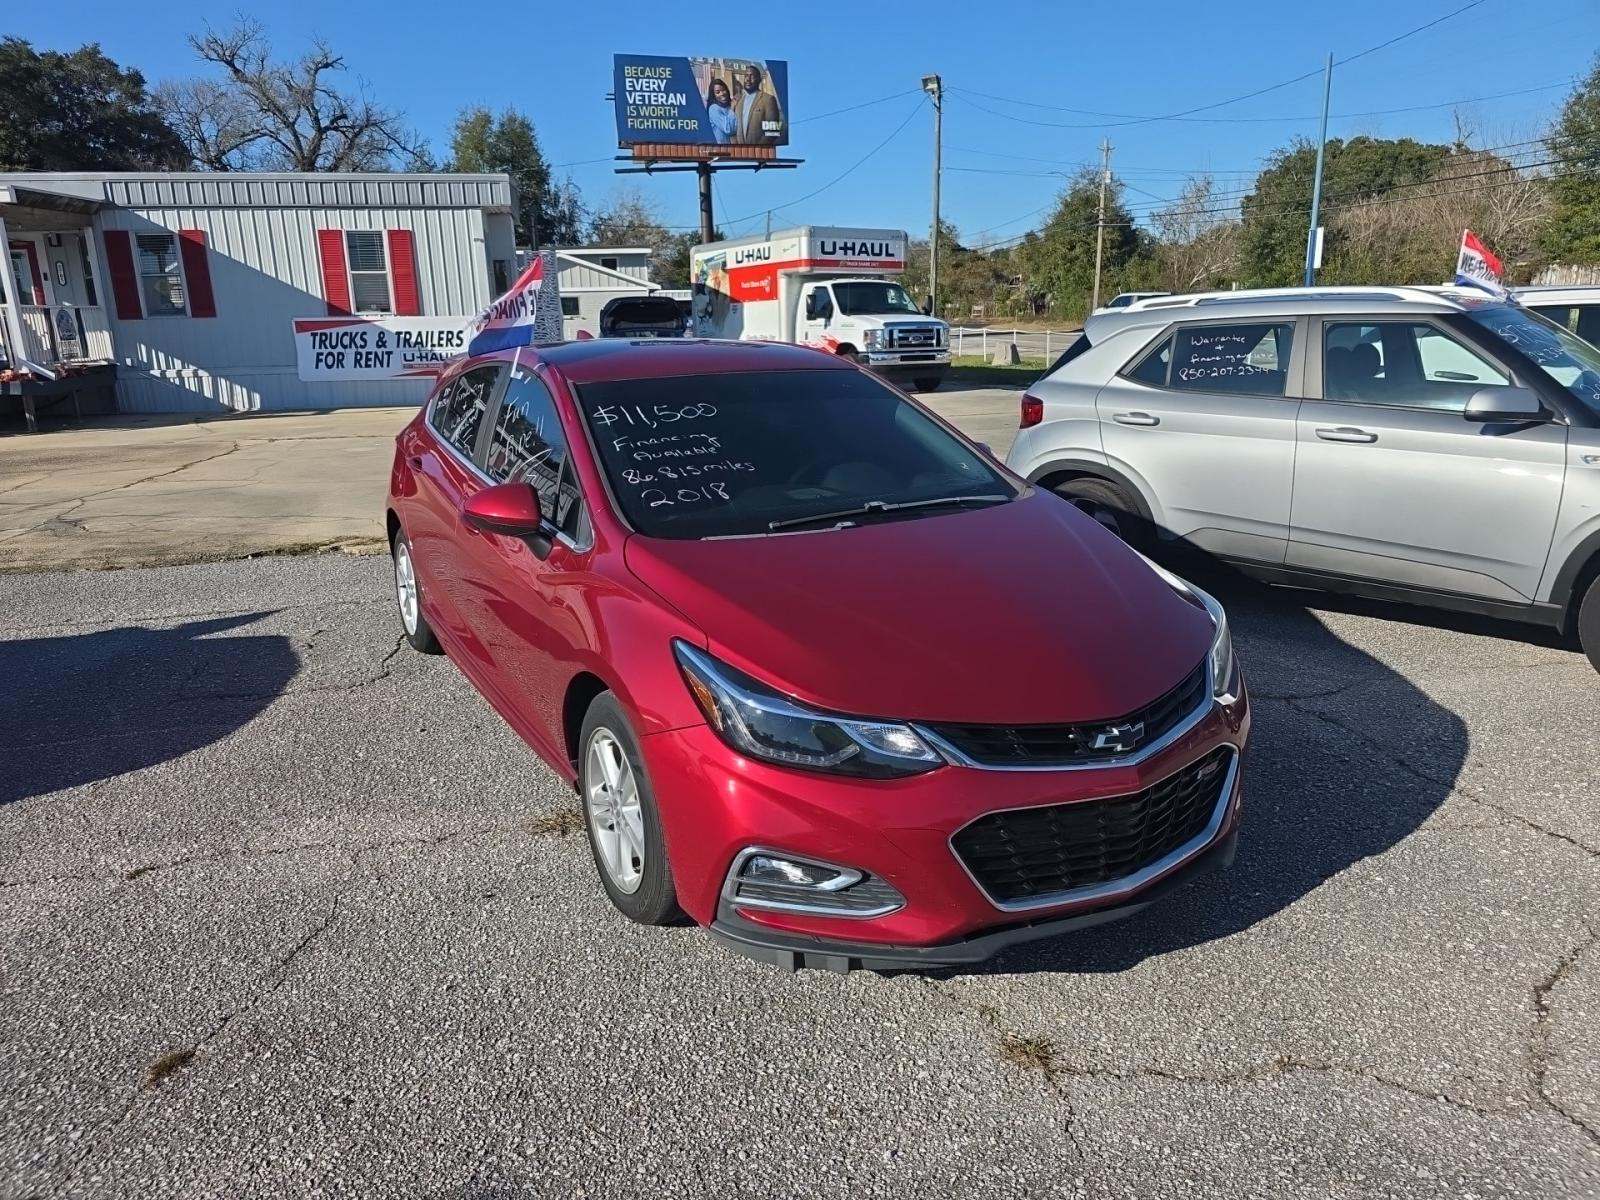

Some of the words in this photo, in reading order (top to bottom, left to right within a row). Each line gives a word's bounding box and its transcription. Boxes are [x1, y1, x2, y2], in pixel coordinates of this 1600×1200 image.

[624, 66, 672, 78] BECAUSE
[625, 79, 666, 91] EVERY
[626, 92, 686, 106] VETERAN
[627, 106, 637, 116] IS
[639, 106, 678, 117] WORTH
[628, 118, 675, 130] FIGHTING
[678, 119, 699, 130] FOR
[821, 241, 895, 257] U-HAUL
[311, 332, 368, 350] TRUCKS
[376, 331, 387, 348] &
[395, 331, 464, 348] TRAILERS
[314, 352, 350, 370] FOR
[354, 351, 393, 369] RENT
[592, 403, 718, 428] $11,500
[641, 482, 730, 507] 2018
